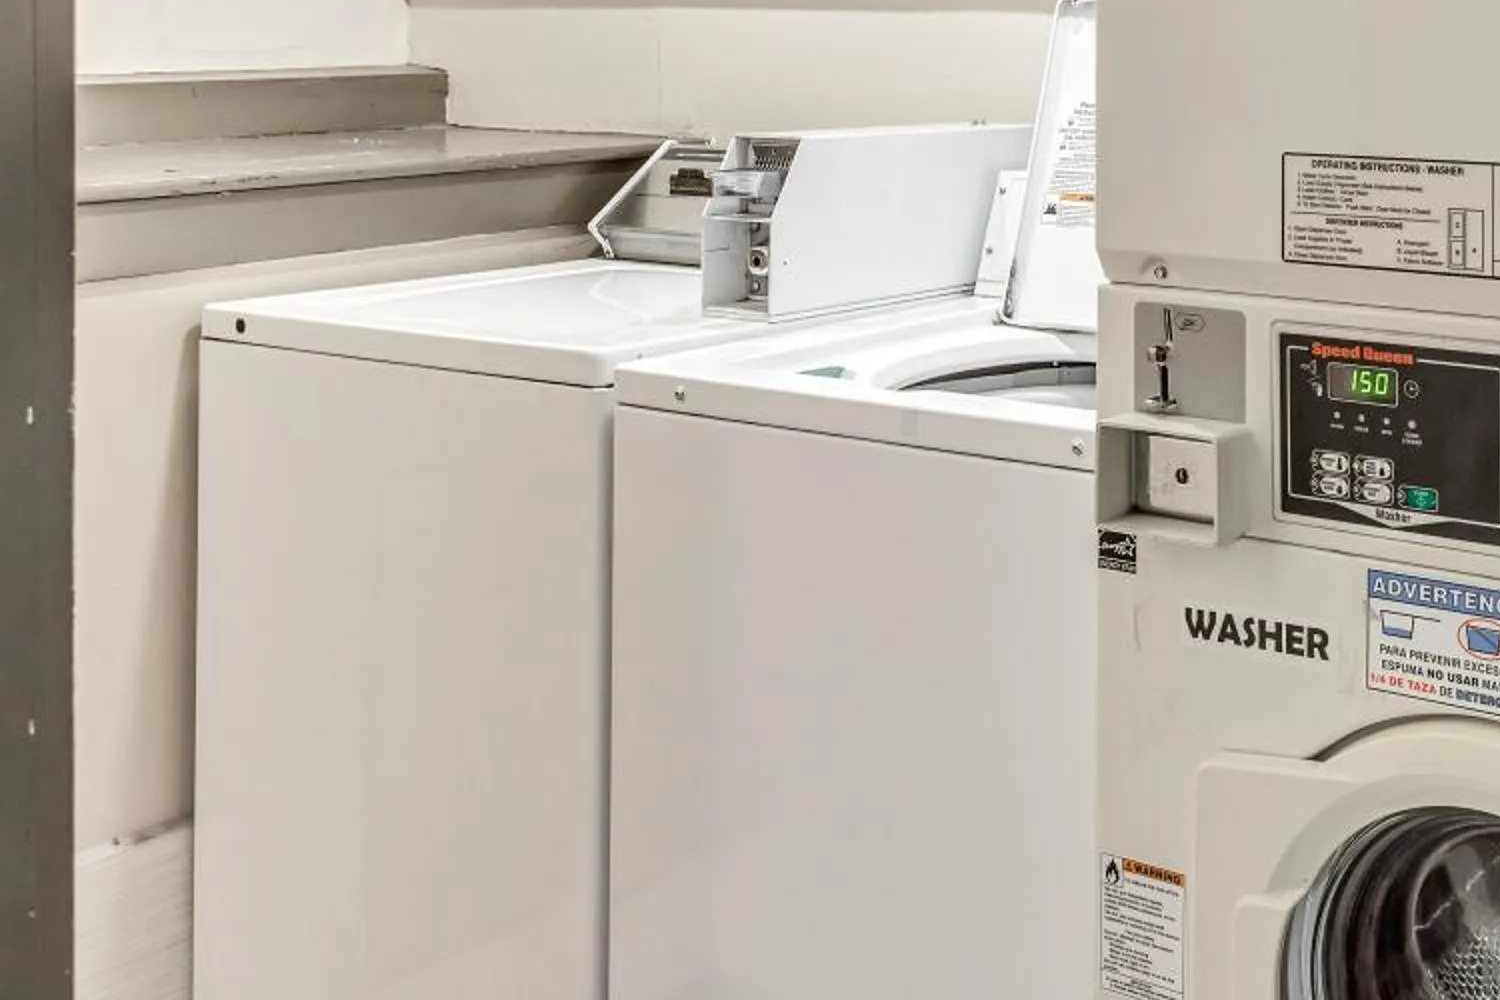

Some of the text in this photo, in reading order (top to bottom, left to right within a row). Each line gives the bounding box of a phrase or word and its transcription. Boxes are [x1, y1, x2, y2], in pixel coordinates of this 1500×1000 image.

[1311, 159, 1465, 176] OPERATING INSTRUCTIONS WASHER
[1311, 342, 1416, 365] Speed Queen
[1351, 369, 1389, 395] 150
[1185, 607, 1330, 661] WASHER
[1379, 643, 1407, 658] PARA
[1409, 648, 1461, 669] PREVENIR
[1371, 674, 1387, 685] 1/4
[1389, 677, 1404, 688] DE
[1408, 680, 1437, 695] TAZA
[1439, 686, 1454, 699] DE
[1381, 659, 1423, 676] ESPUMA
[1427, 669, 1444, 681] NO
[1447, 673, 1479, 688] USAR
